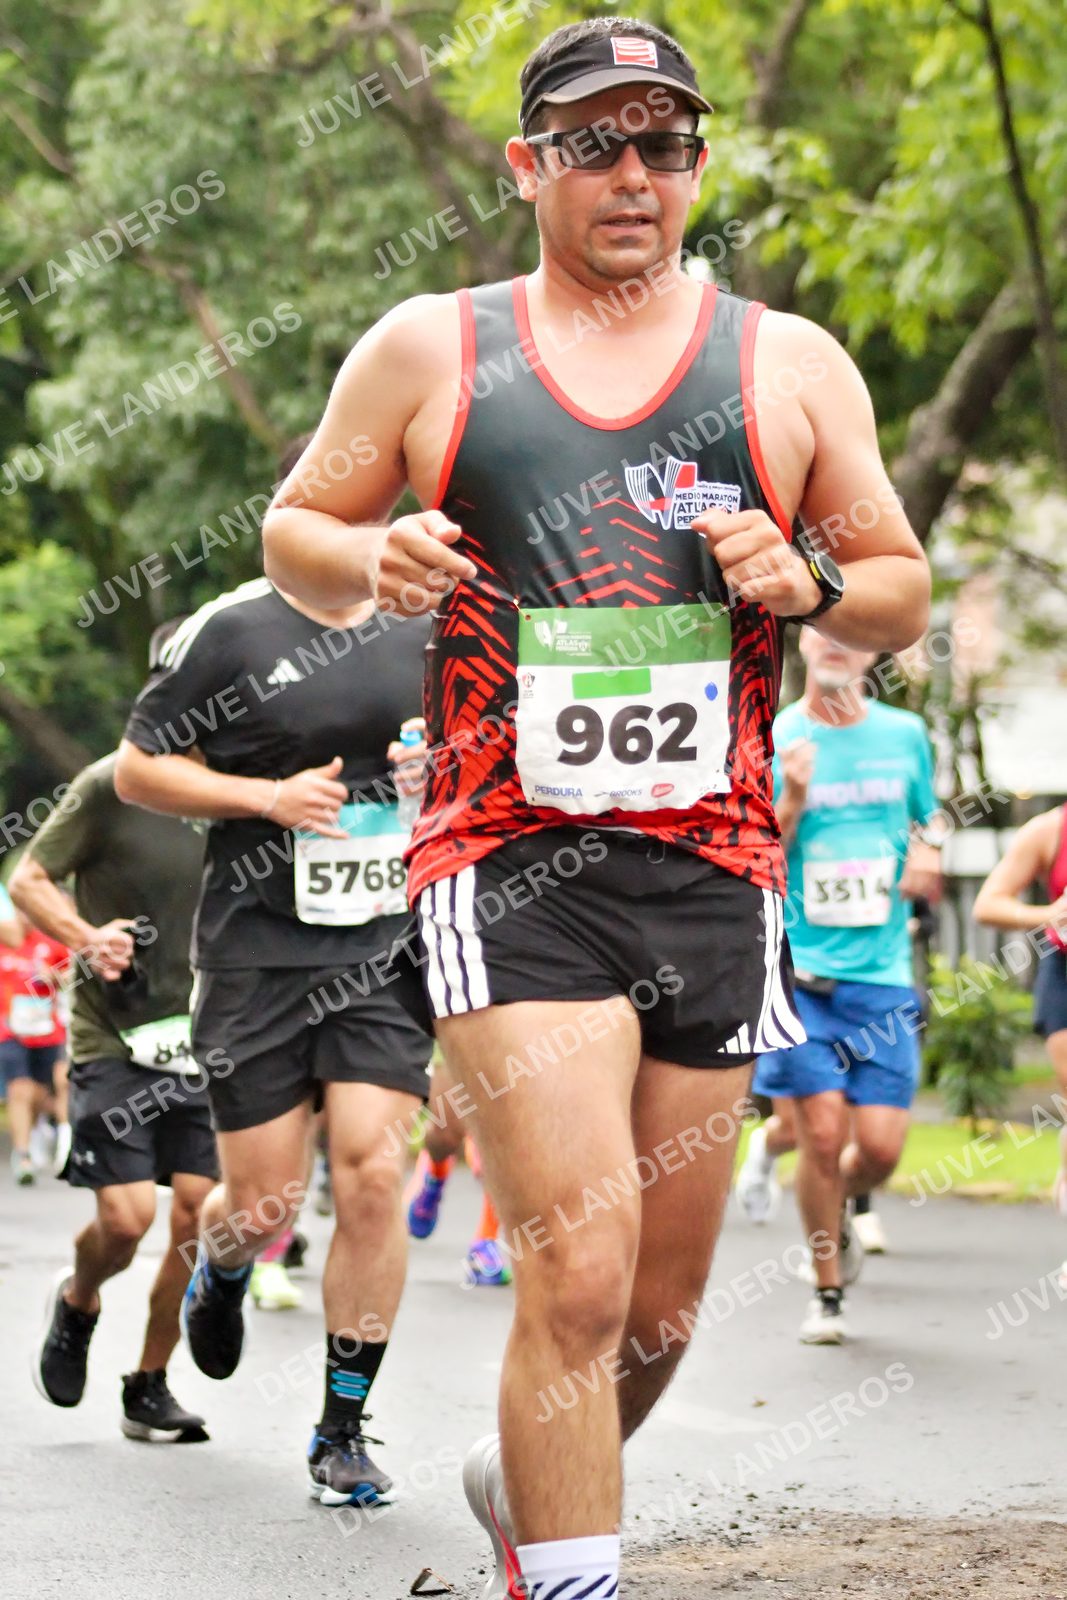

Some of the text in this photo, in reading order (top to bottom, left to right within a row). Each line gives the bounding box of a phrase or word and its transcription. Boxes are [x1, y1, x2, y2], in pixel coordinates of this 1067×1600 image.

[676, 492, 738, 503] MEDIO MARATÓN
[556, 702, 697, 766] 962
[535, 785, 583, 797] PERDURA
[609, 789, 643, 797] BROOKS
[307, 857, 407, 894] 5768
